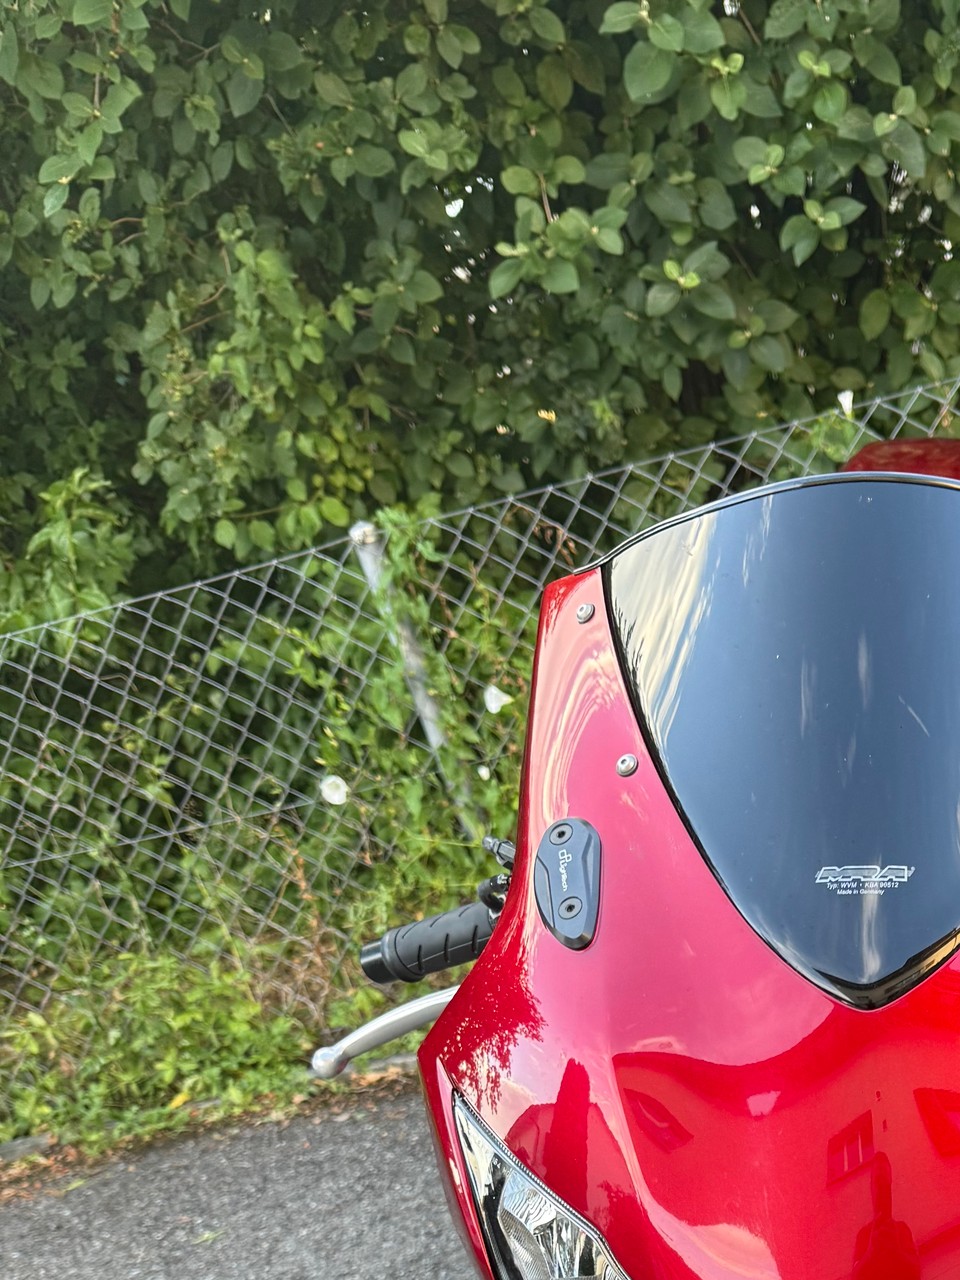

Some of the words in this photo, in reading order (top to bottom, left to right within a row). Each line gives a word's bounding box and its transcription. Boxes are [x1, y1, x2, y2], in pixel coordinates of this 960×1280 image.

[815, 865, 908, 883] MRA
[840, 881, 857, 889] WVM
[859, 888, 885, 896] Germany
